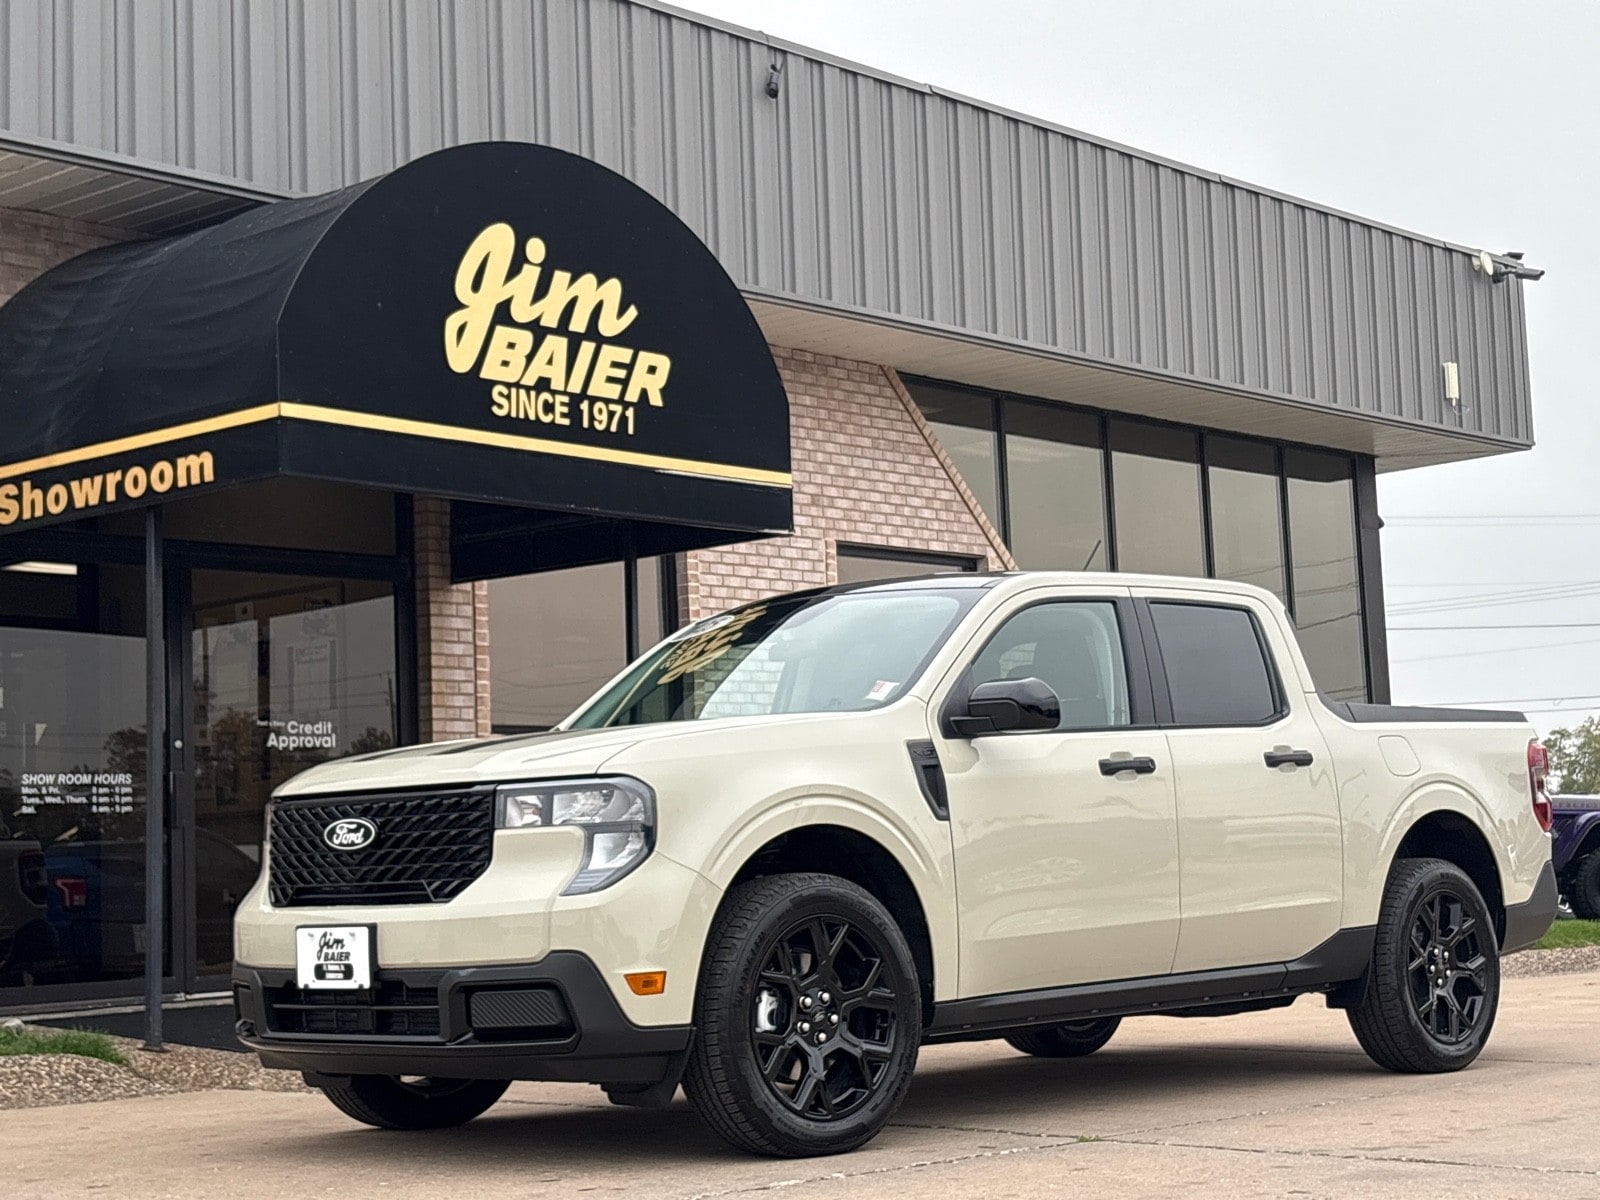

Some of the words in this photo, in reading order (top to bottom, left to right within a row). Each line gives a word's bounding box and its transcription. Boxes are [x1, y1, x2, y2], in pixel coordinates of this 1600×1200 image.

[444, 222, 639, 374] Jim
[479, 325, 671, 407] BAIER
[491, 385, 571, 426] SINCE
[579, 400, 635, 435] 1971
[0, 451, 215, 525] Showroom
[287, 720, 332, 734] Credit
[266, 732, 336, 751] Approval
[21, 774, 56, 785] SHOW
[58, 774, 92, 785] ROOM
[94, 773, 132, 785] HOURS
[332, 823, 365, 844] Ford
[316, 931, 345, 962] Jim
[323, 951, 351, 962] BAIER
